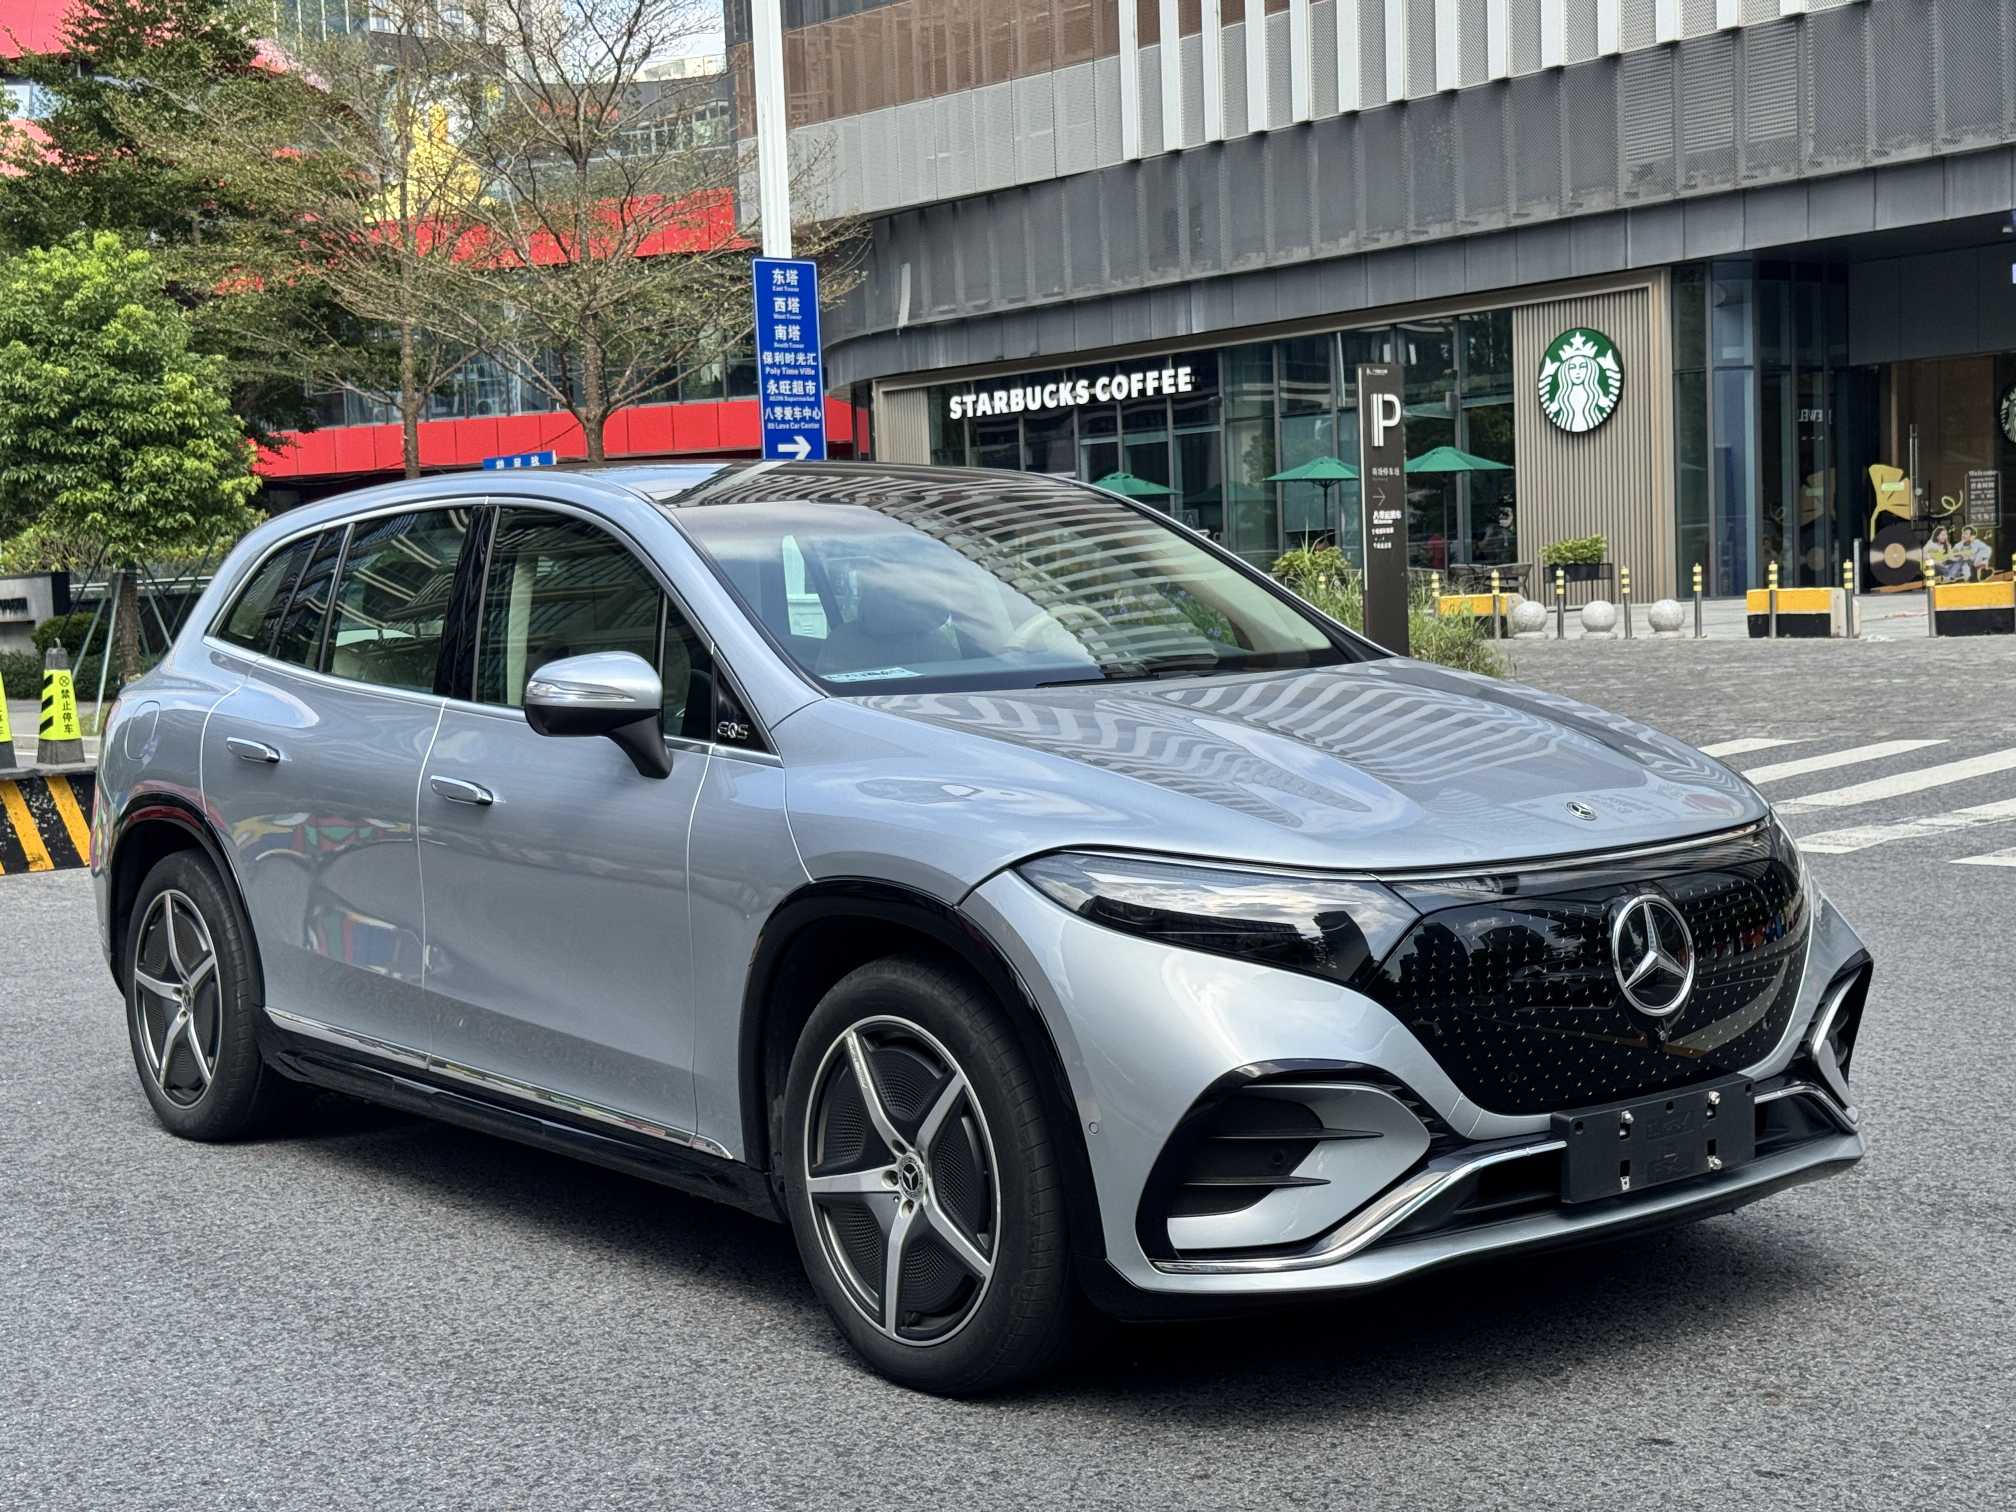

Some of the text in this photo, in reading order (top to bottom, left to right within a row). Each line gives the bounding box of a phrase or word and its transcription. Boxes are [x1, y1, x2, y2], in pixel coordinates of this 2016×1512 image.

[772, 269, 798, 285] 东塔
[773, 297, 800, 313] 西塔
[774, 325, 801, 341] 南塔
[763, 352, 817, 365] 保利时光汇
[766, 367, 780, 376] Poly
[767, 380, 816, 394] 永旺超市
[949, 366, 1193, 420] STARBUCKS COFFEE
[765, 406, 821, 420] 八零爱车中心
[61, 689, 73, 734] 禁止停车
[717, 721, 749, 740] EQS
